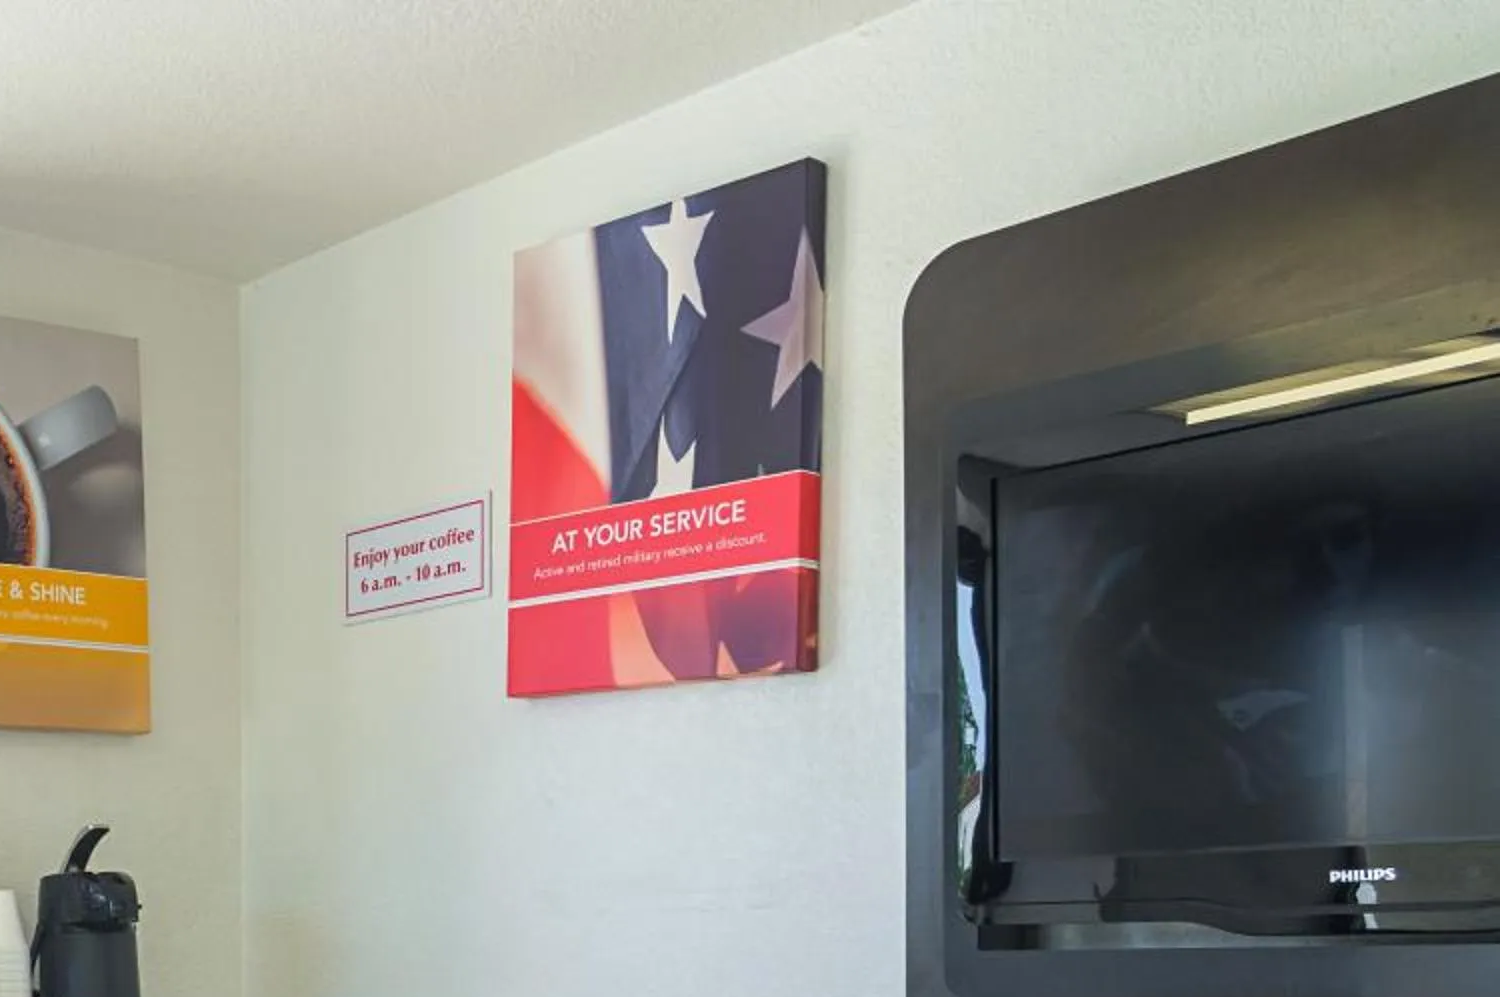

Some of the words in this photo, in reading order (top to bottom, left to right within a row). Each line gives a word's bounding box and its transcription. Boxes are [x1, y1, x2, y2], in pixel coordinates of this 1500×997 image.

[552, 530, 579, 554] AT
[584, 519, 643, 548] YOUR
[650, 499, 747, 537] SERVICE
[354, 547, 390, 569] Enjoy
[393, 541, 425, 564] your
[429, 528, 474, 551] coffee
[533, 566, 564, 580] Active
[566, 562, 585, 576] and
[587, 554, 621, 572] retired
[623, 549, 661, 566] military
[664, 543, 703, 558] receive
[705, 542, 713, 552] a
[9, 580, 23, 600] &
[30, 582, 86, 605] SHINE
[360, 577, 369, 594] 6
[371, 575, 402, 592] a.m.
[416, 563, 431, 581] 10
[434, 561, 466, 578] a.m.
[1329, 867, 1397, 883] PHILIPS
